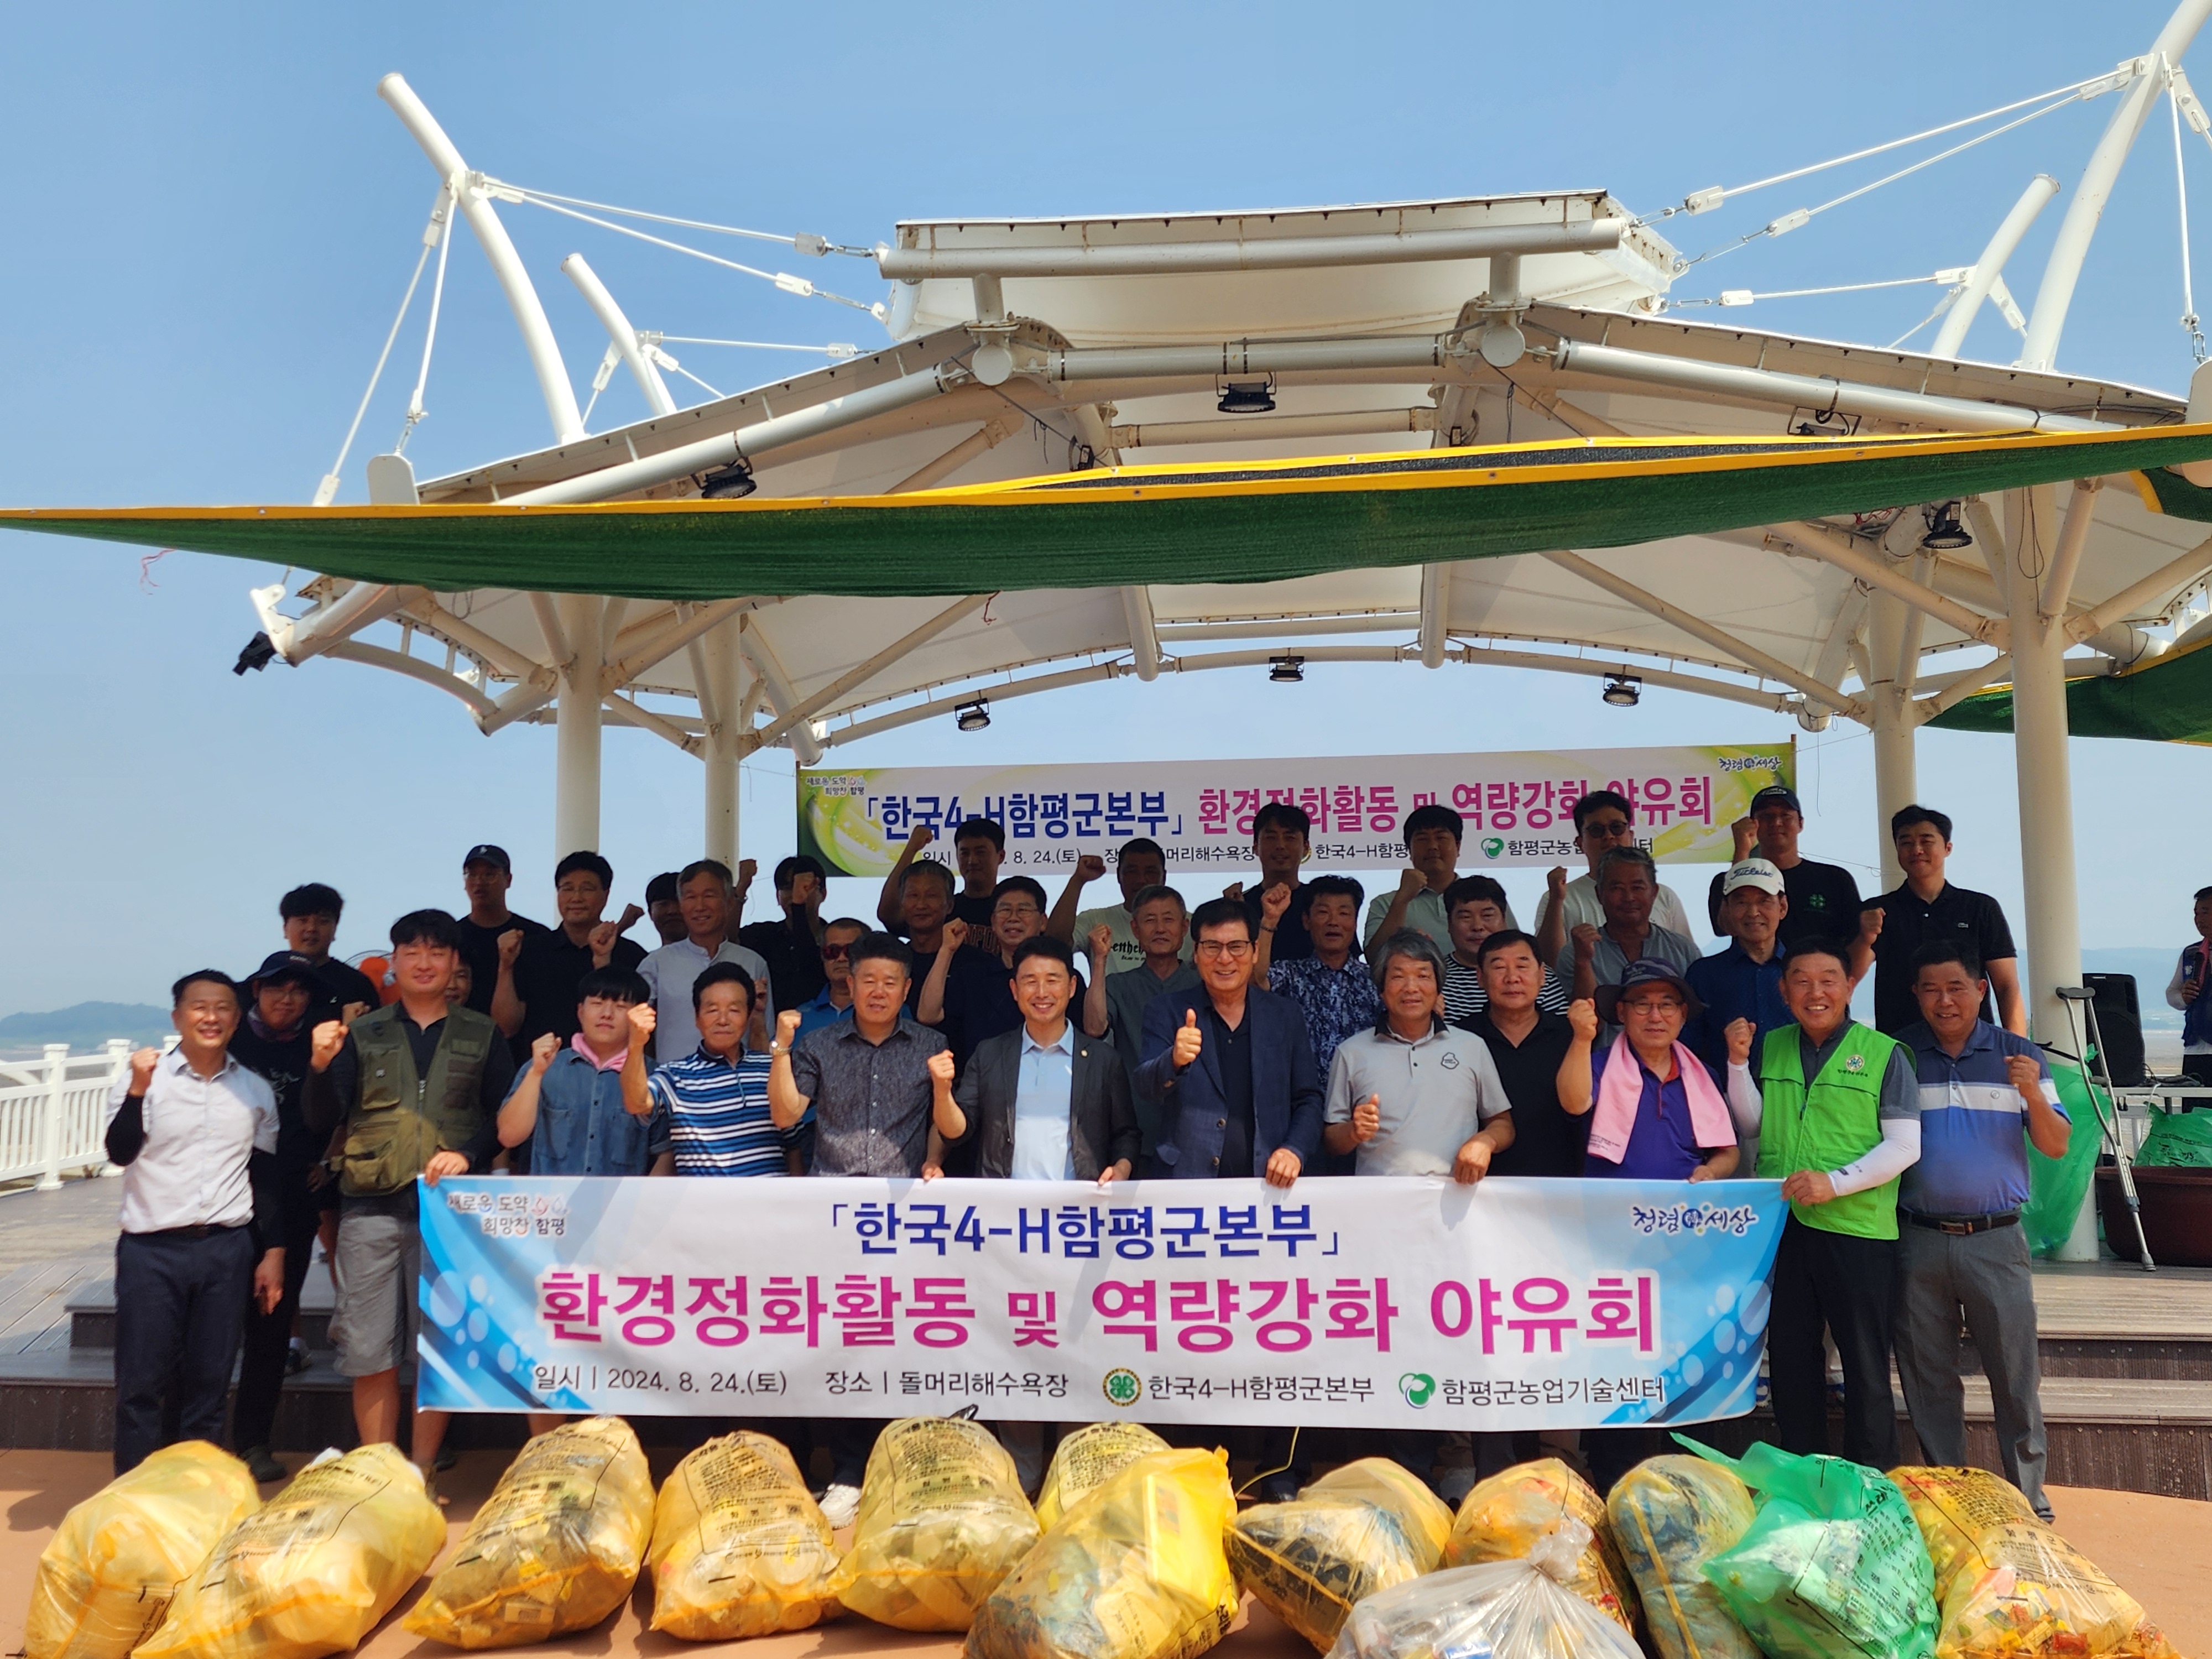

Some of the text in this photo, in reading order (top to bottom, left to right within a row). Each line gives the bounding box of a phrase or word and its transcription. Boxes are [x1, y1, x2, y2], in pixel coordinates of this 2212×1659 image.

[850, 787, 864, 795] 함평
[1033, 848, 1081, 864] 24.(토)
[1161, 846, 1255, 862] 머리해수욕장
[1730, 867, 1773, 880] Titleist
[449, 1194, 529, 1213] 새로운 도약
[484, 1217, 565, 1235] 희망찬 함평
[832, 1203, 1338, 1260] 「한국4-H함평군본부」
[542, 1272, 1653, 1355] 환경정화활동 및 역량강화 야유회
[534, 1365, 581, 1391] 일시
[608, 1368, 669, 1391] 2024.
[679, 1372, 700, 1392] 8.
[710, 1370, 787, 1396] 24.(토)
[825, 1370, 873, 1395] 장소
[899, 1370, 1068, 1398] 돌머리해수욕장
[1148, 1375, 1375, 1404] 한국4-H함평군본부
[1442, 1375, 1666, 1406] 함평군농업기술센터
